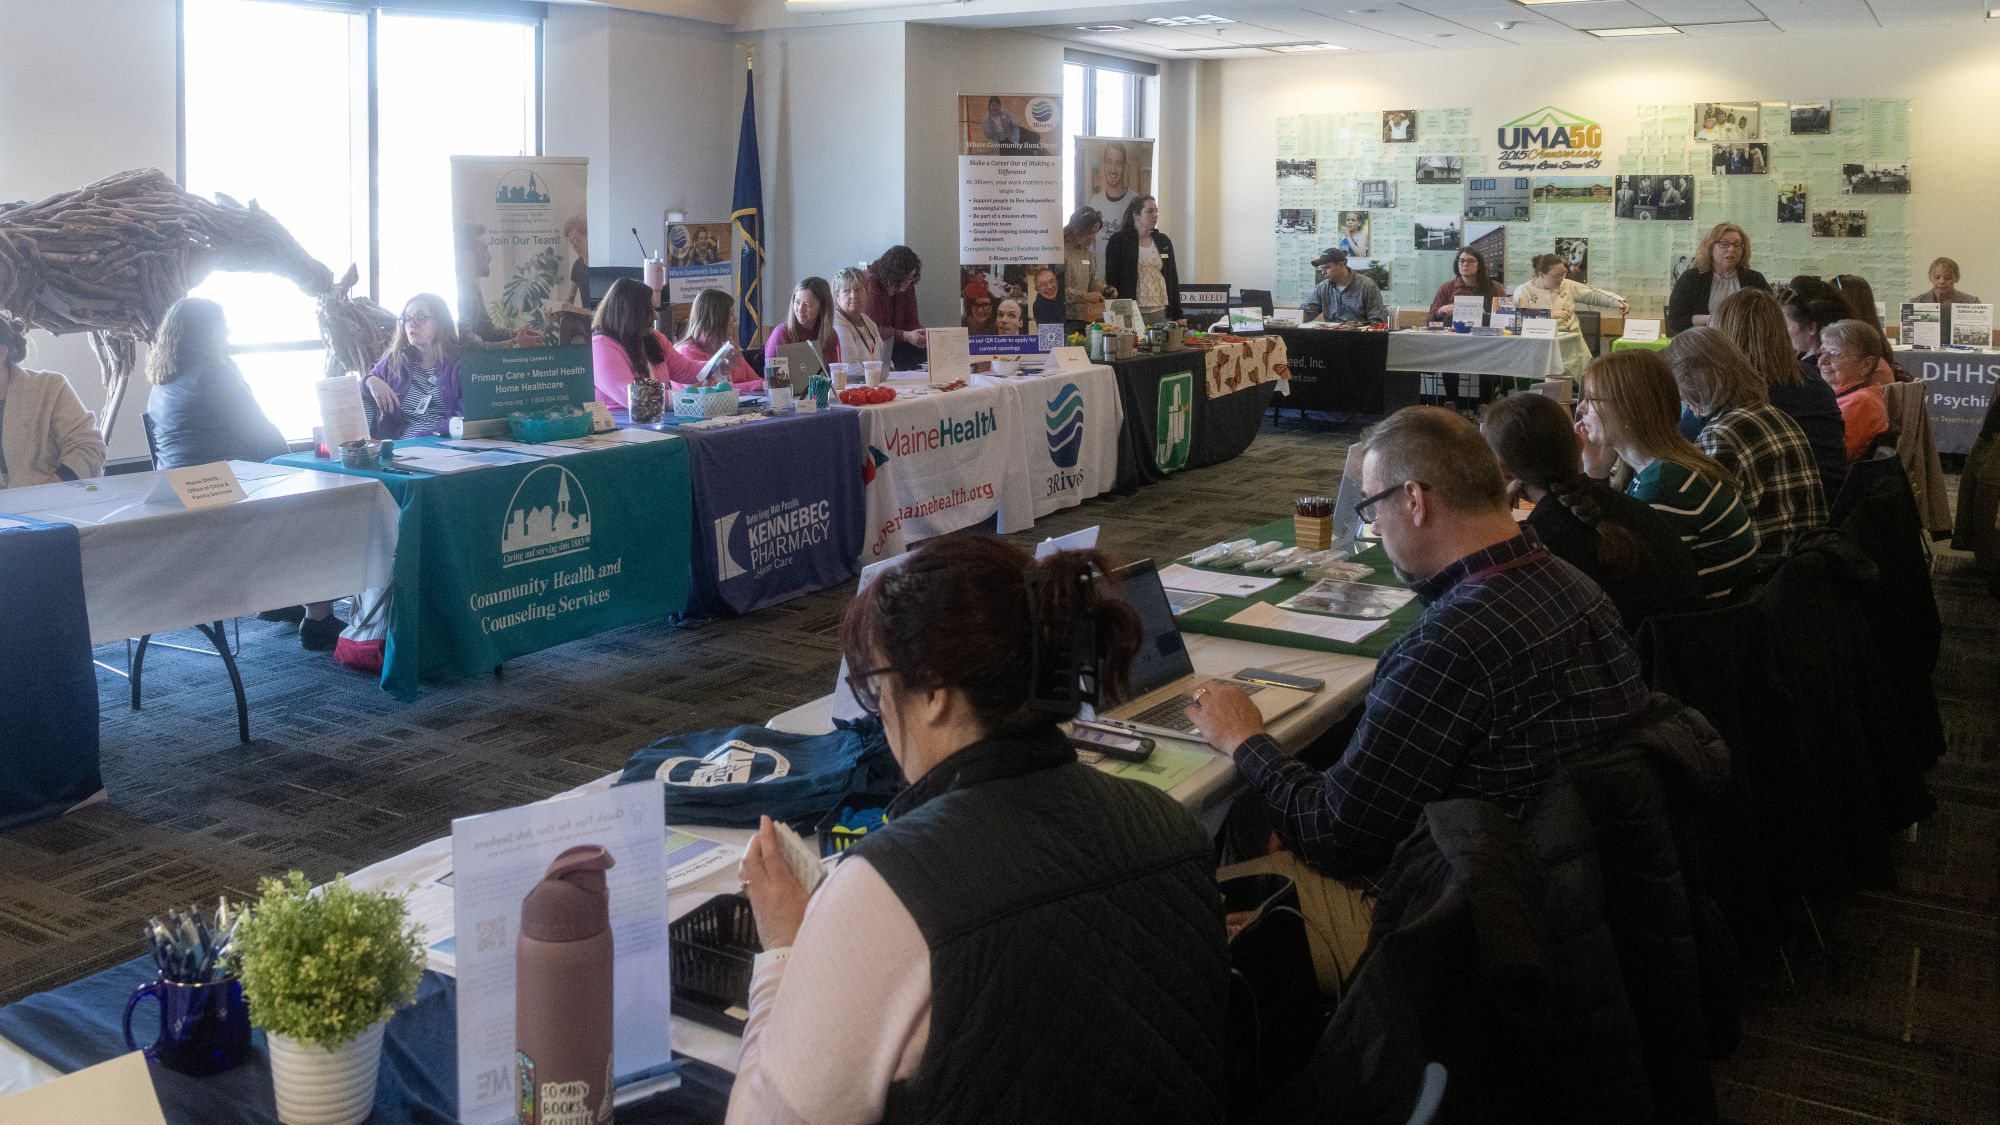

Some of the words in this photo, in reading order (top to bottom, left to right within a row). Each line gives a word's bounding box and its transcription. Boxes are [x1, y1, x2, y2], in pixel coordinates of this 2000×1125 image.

[986, 141, 1023, 150] Community
[1041, 142, 1058, 150] Deep!
[1498, 150, 1528, 160] 2015
[1528, 149, 1602, 159] Anniversary
[1021, 160, 1029, 168] of
[1028, 160, 1051, 168] Making
[1499, 160, 1536, 171] Changing
[1536, 160, 1559, 170] Lives
[1559, 160, 1583, 170] Since
[997, 168, 1027, 176] Difference
[488, 235, 510, 246] Join
[511, 235, 531, 246] Our
[533, 235, 562, 246] Team!
[1189, 294, 1197, 302] &
[1199, 293, 1223, 302] REED
[1309, 355, 1326, 370] Inc.
[471, 373, 505, 383] Primary
[505, 371, 526, 381] Care
[532, 368, 559, 378] Mental
[560, 366, 586, 376] Health
[1923, 361, 2000, 385] DHHS
[495, 385, 520, 394] Home
[521, 381, 565, 392] Healthcare
[883, 407, 997, 457] MaineHealth
[185, 479, 203, 487] Maine
[209, 482, 224, 490] Child
[210, 489, 233, 498] Services
[748, 499, 830, 550] KENNEBEC
[503, 550, 524, 564] Caring
[524, 549, 536, 559] and
[535, 545, 559, 558] serving
[558, 541, 570, 552] since
[750, 519, 831, 571] PHARMACY
[773, 555, 794, 570] Care
[470, 577, 549, 612] Community
[552, 564, 595, 590] Health
[598, 557, 623, 578] and
[481, 601, 556, 635] Counseling
[558, 588, 611, 614] Services
[542, 1085, 558, 1099] SO
[560, 1084, 588, 1098] MANY
[543, 1101, 586, 1116] BOOKS,
